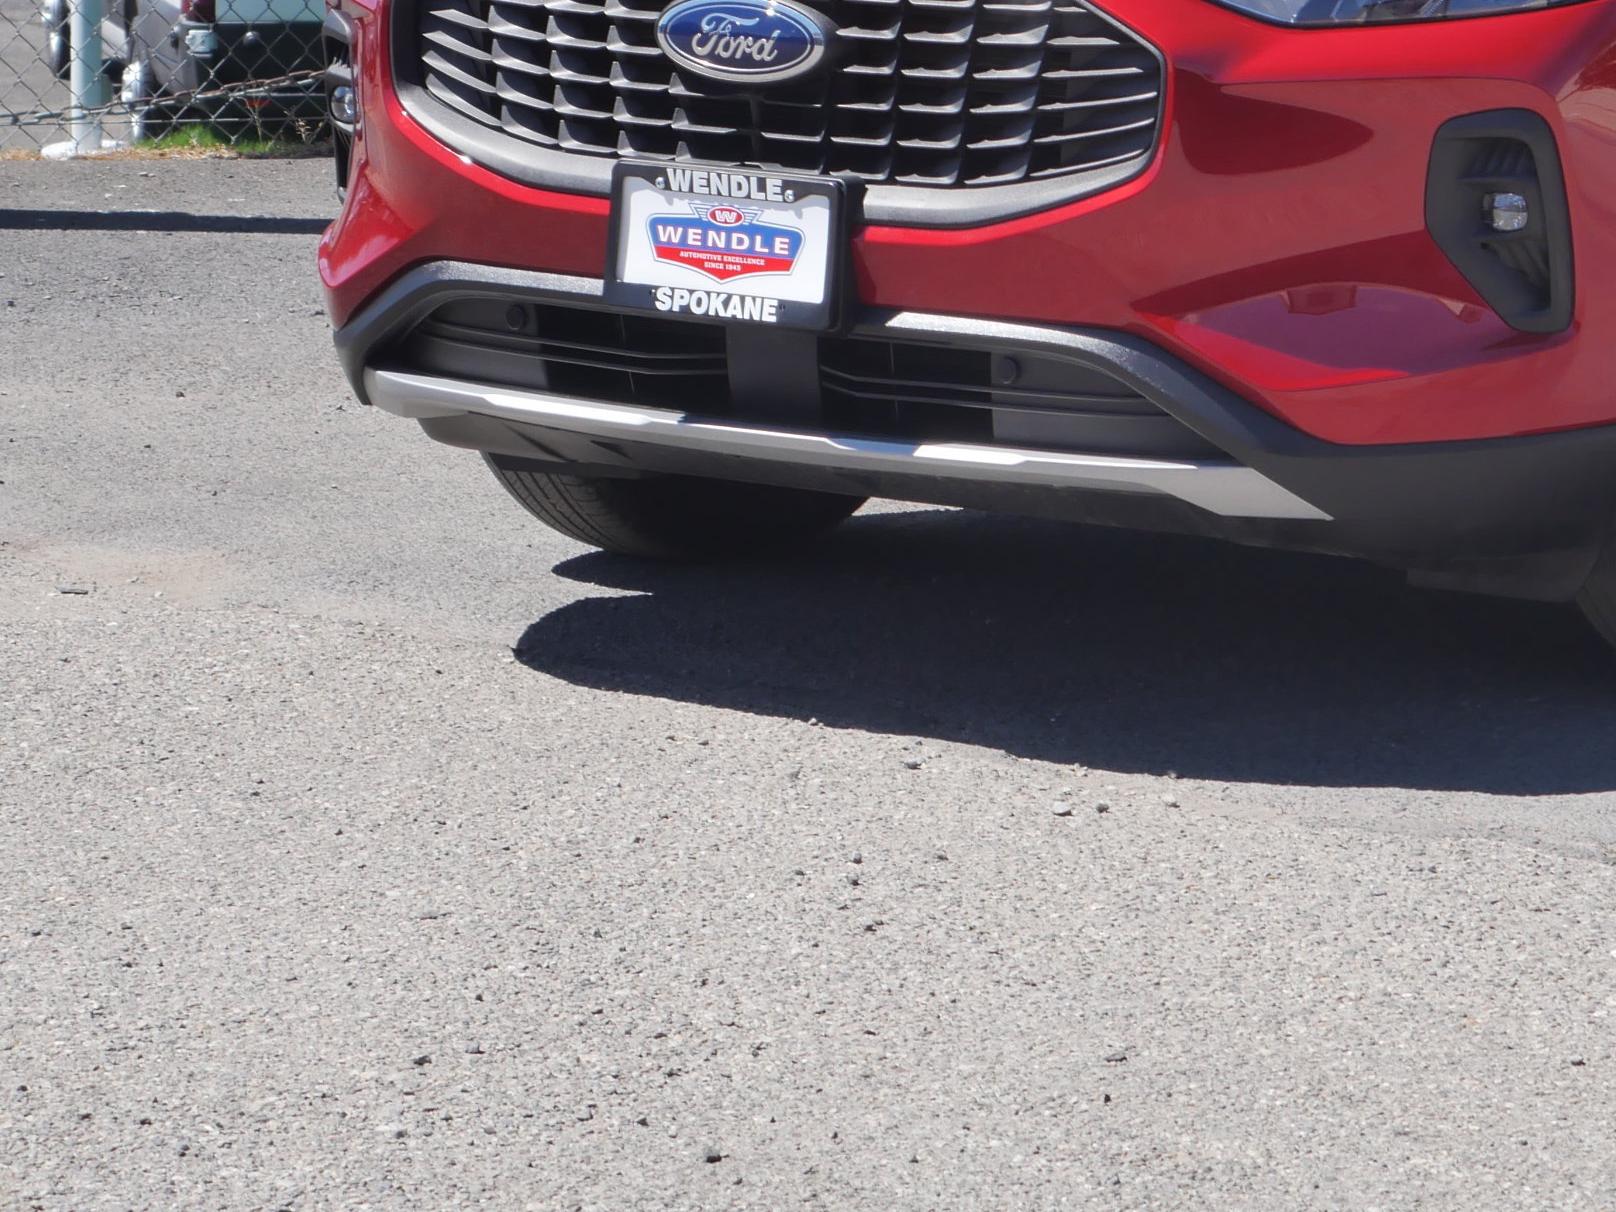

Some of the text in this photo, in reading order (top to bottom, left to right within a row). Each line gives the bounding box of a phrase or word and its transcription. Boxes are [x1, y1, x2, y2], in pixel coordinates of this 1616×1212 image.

[692, 13, 781, 61] Ford
[666, 168, 784, 202] WENDLE
[656, 224, 790, 255] WENDLE
[679, 250, 766, 266] AUTOMOTIVE EXCELLENCE
[704, 261, 724, 270] SINCE
[654, 286, 778, 322] SPOKANE
